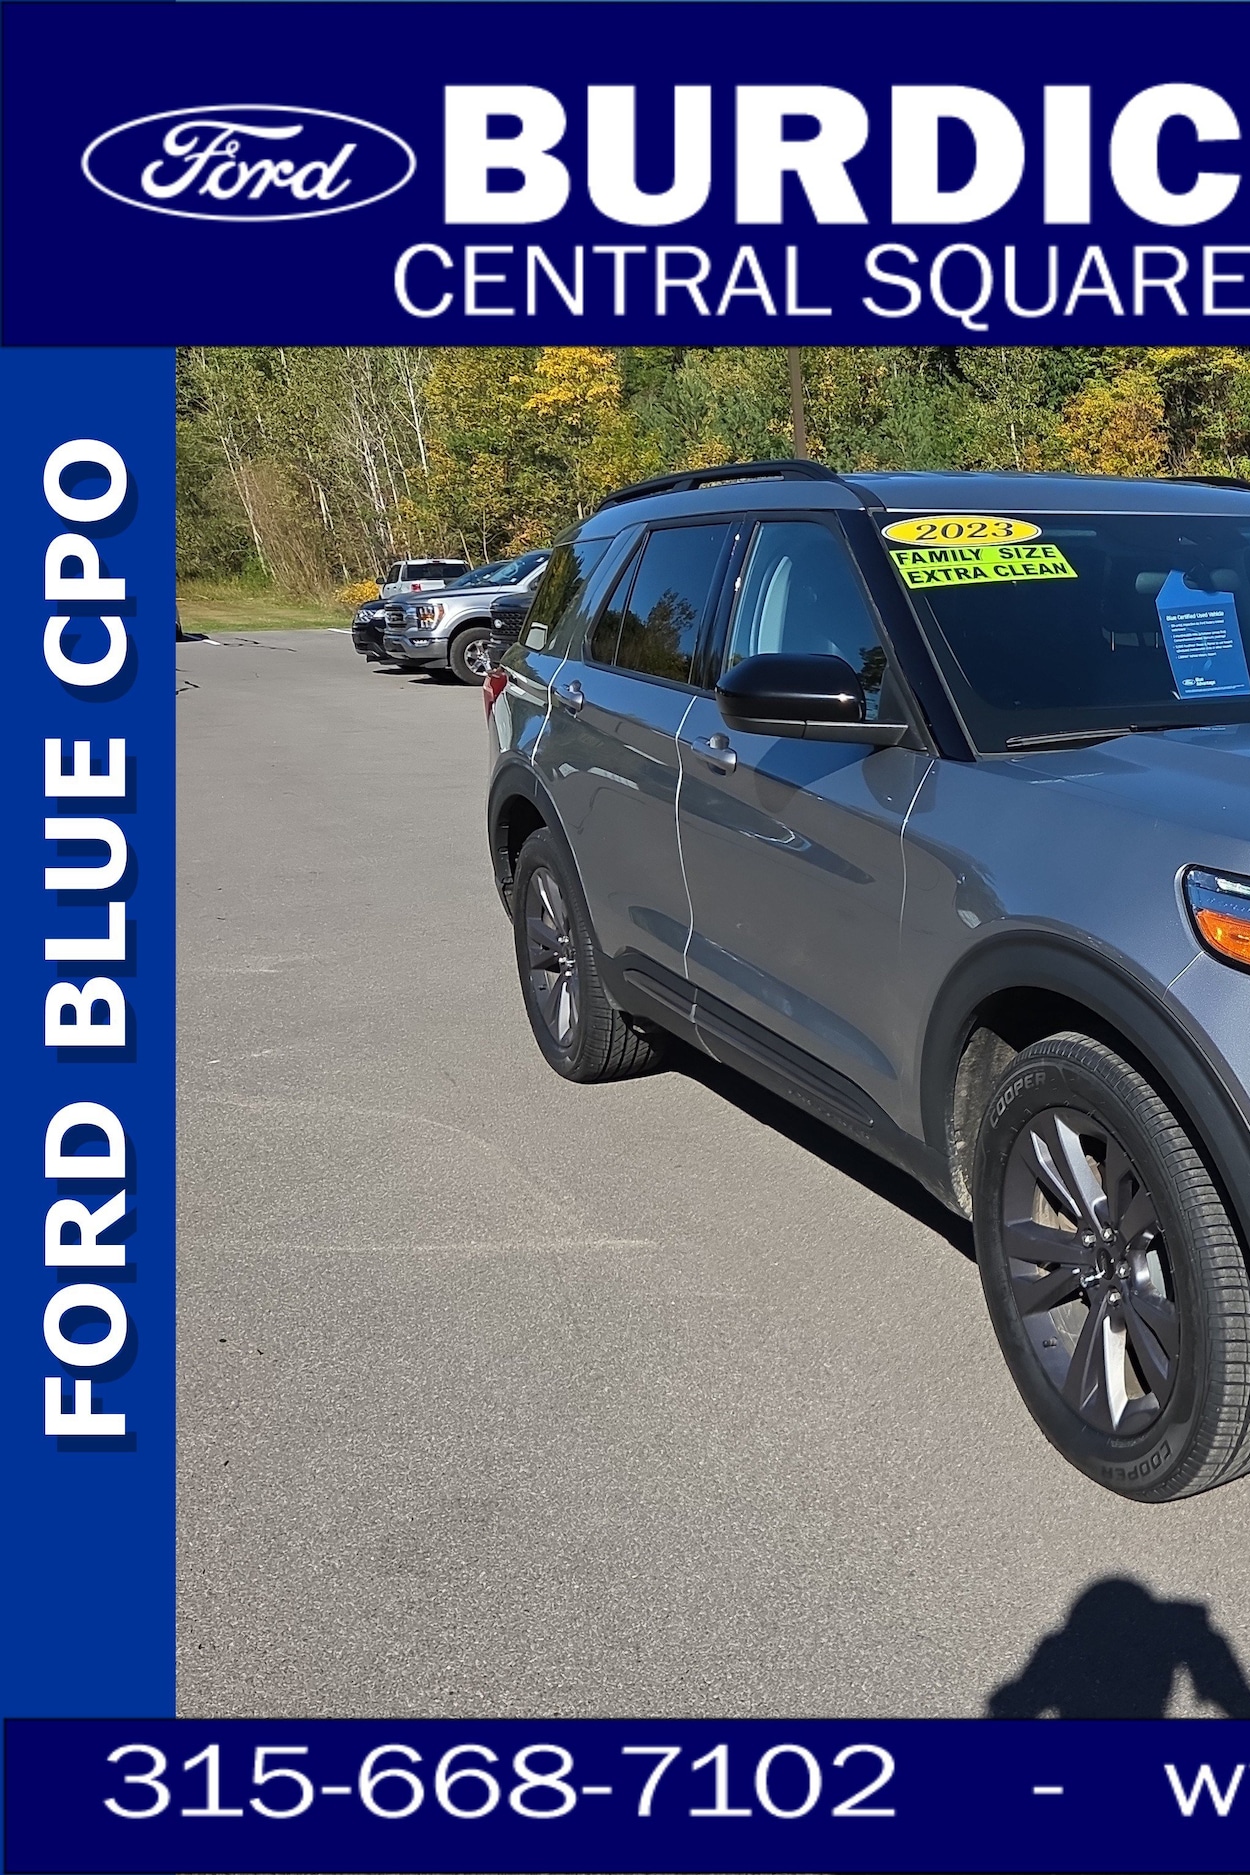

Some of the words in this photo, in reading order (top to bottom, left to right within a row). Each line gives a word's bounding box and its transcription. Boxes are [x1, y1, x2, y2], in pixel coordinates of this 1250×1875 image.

[915, 522, 1014, 541] 2023
[895, 548, 981, 566] FAMILY
[1000, 546, 1057, 560] SIZE
[906, 567, 988, 584] EXTRA
[993, 562, 1068, 578] CLEAN
[990, 1072, 1046, 1129] COOPER
[1101, 1440, 1171, 1480] COOPER
